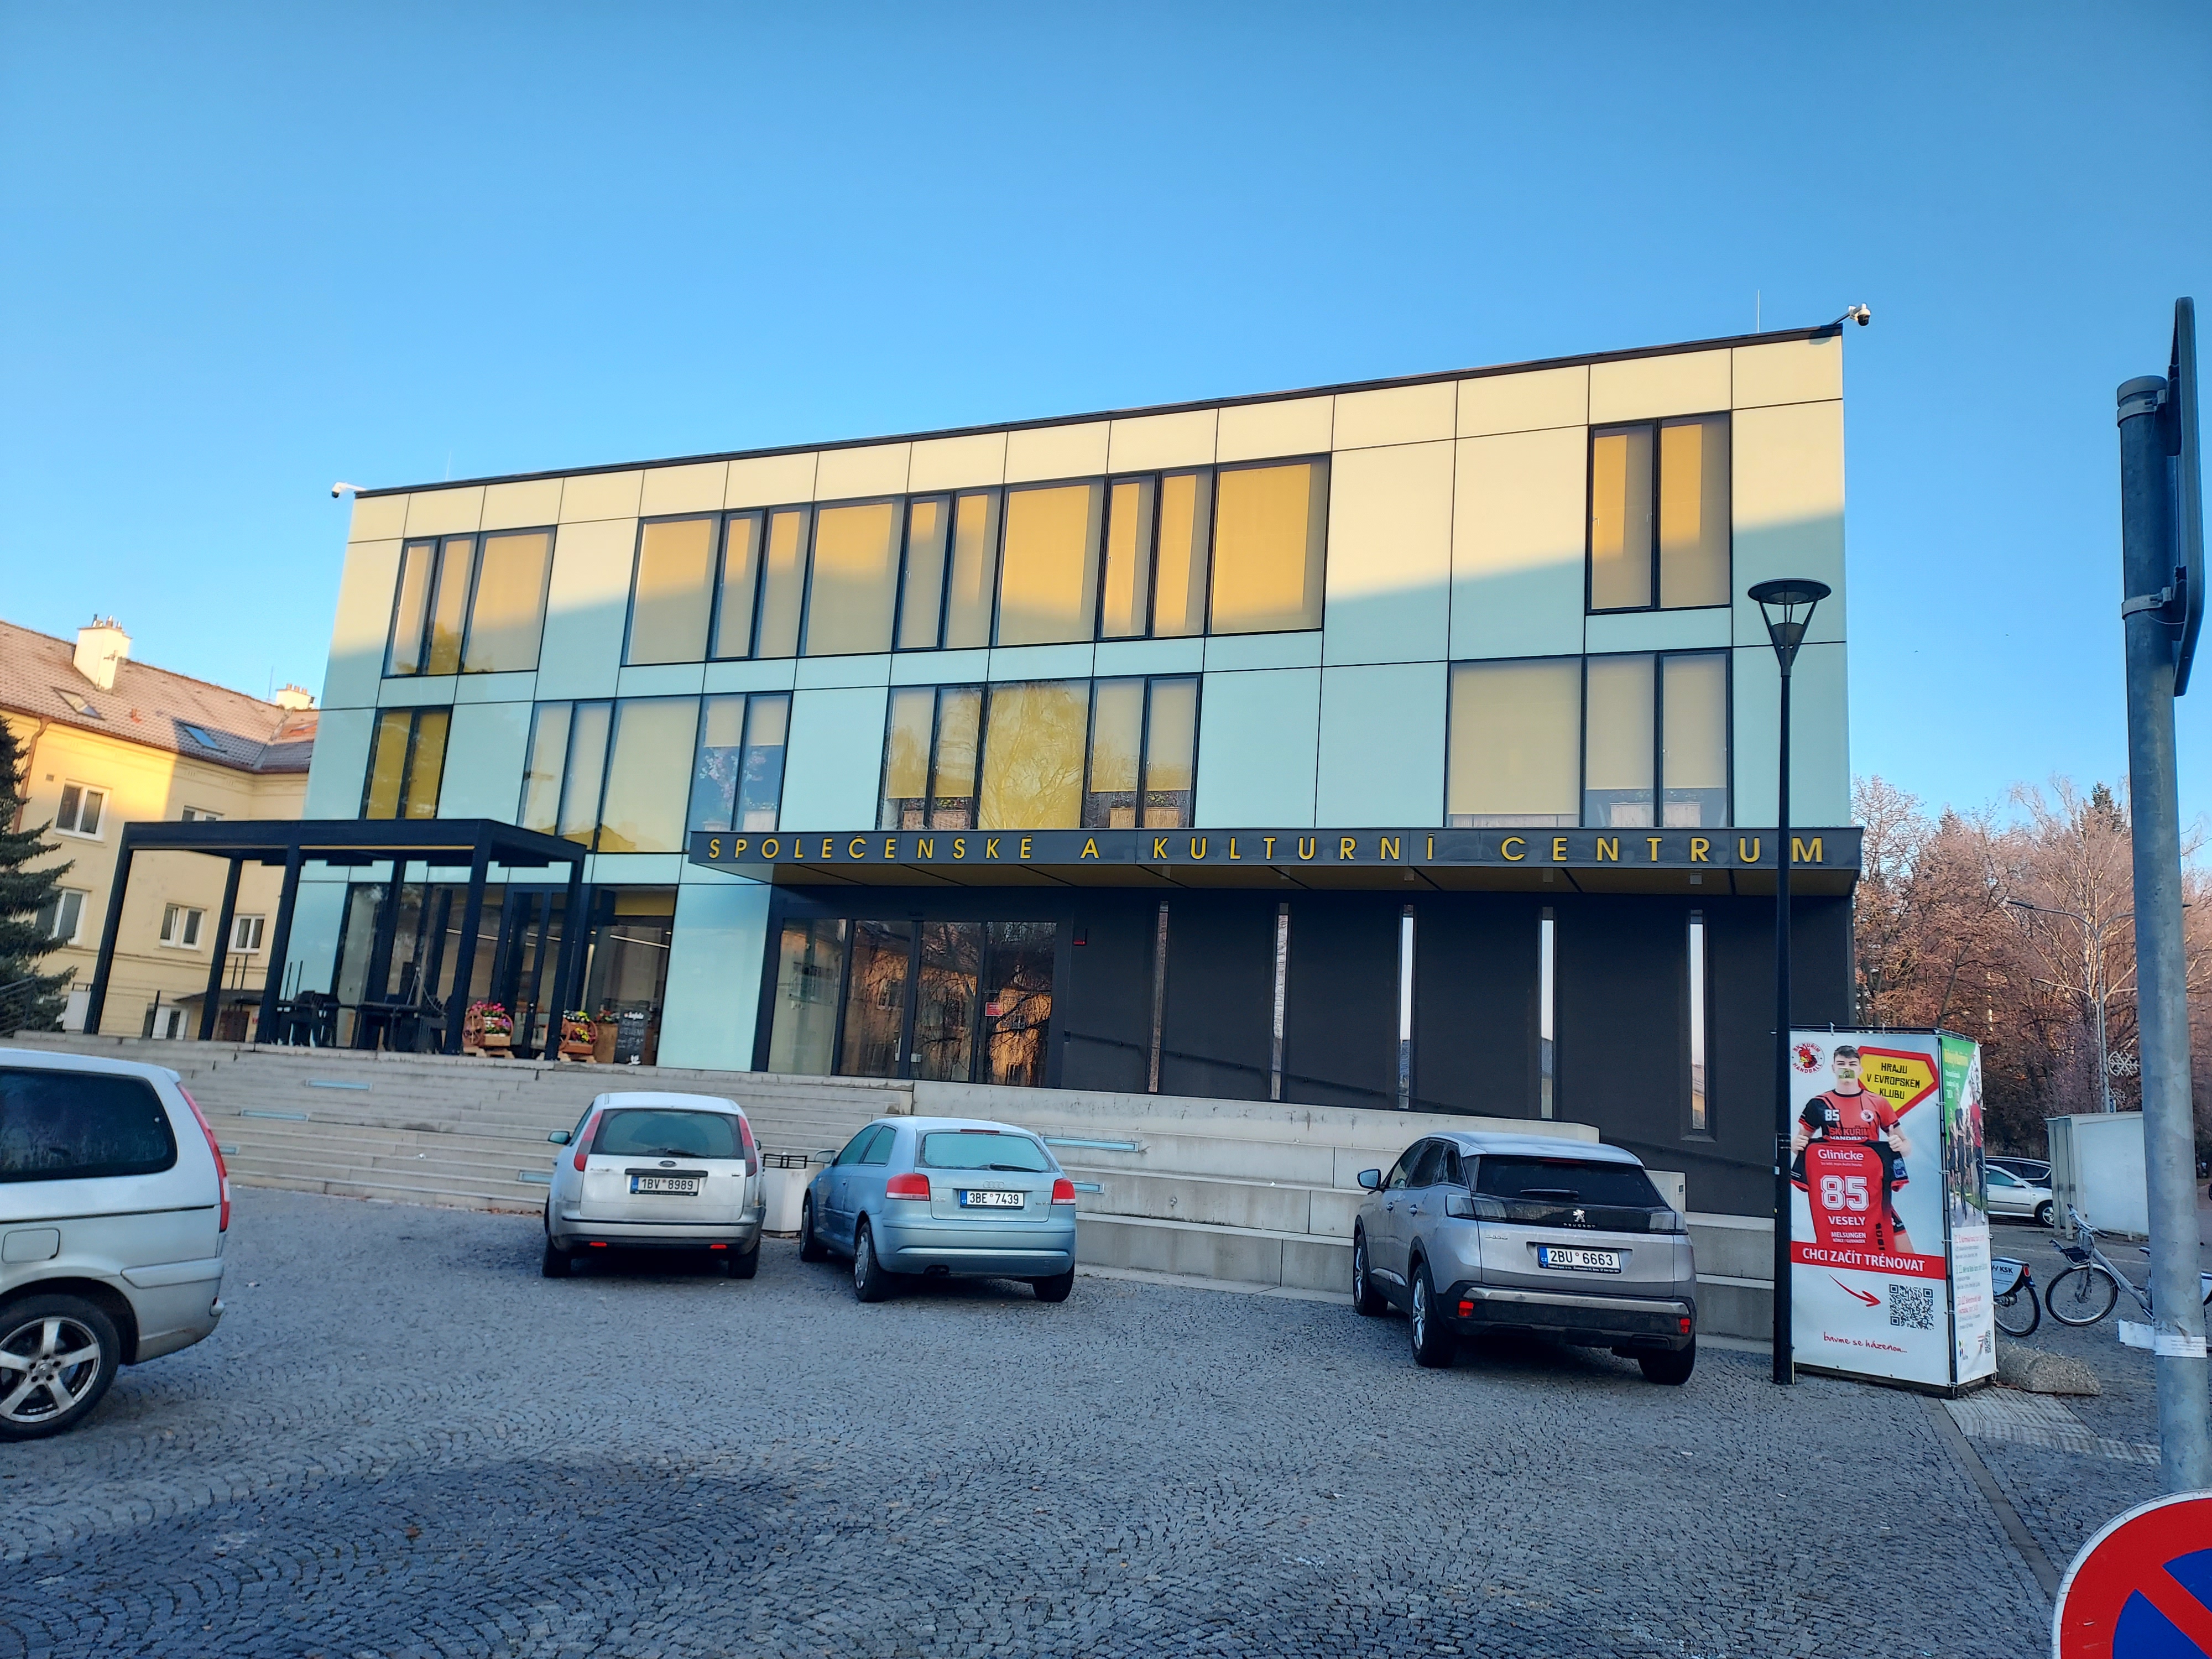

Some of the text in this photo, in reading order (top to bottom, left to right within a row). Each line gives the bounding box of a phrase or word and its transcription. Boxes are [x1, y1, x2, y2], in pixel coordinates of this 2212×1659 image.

[708, 833, 1823, 863] SPOLEČENSKÉ A KULTURNÍ CENTRUM
[1881, 1062, 1908, 1074] HRAJU
[1867, 1073, 1921, 1088] V EVROPSKÉM
[1879, 1088, 1905, 1099] KLUBU
[1825, 1109, 1840, 1121] 85
[1818, 1149, 1864, 1161] Glinicke
[641, 1179, 660, 1190] 1BV
[668, 1180, 693, 1190] 8989
[969, 1193, 988, 1204] 3BE
[995, 1193, 1019, 1204] 7439
[1820, 1175, 1869, 1211] 85
[1828, 1215, 1866, 1225] VESELY
[1550, 1250, 1573, 1262] 2BU
[1583, 1253, 1613, 1266] 6663
[1803, 1248, 1925, 1272] CHCI ZAČÍT TRÉNOVAT
[1824, 1332, 1850, 1344] bavme
